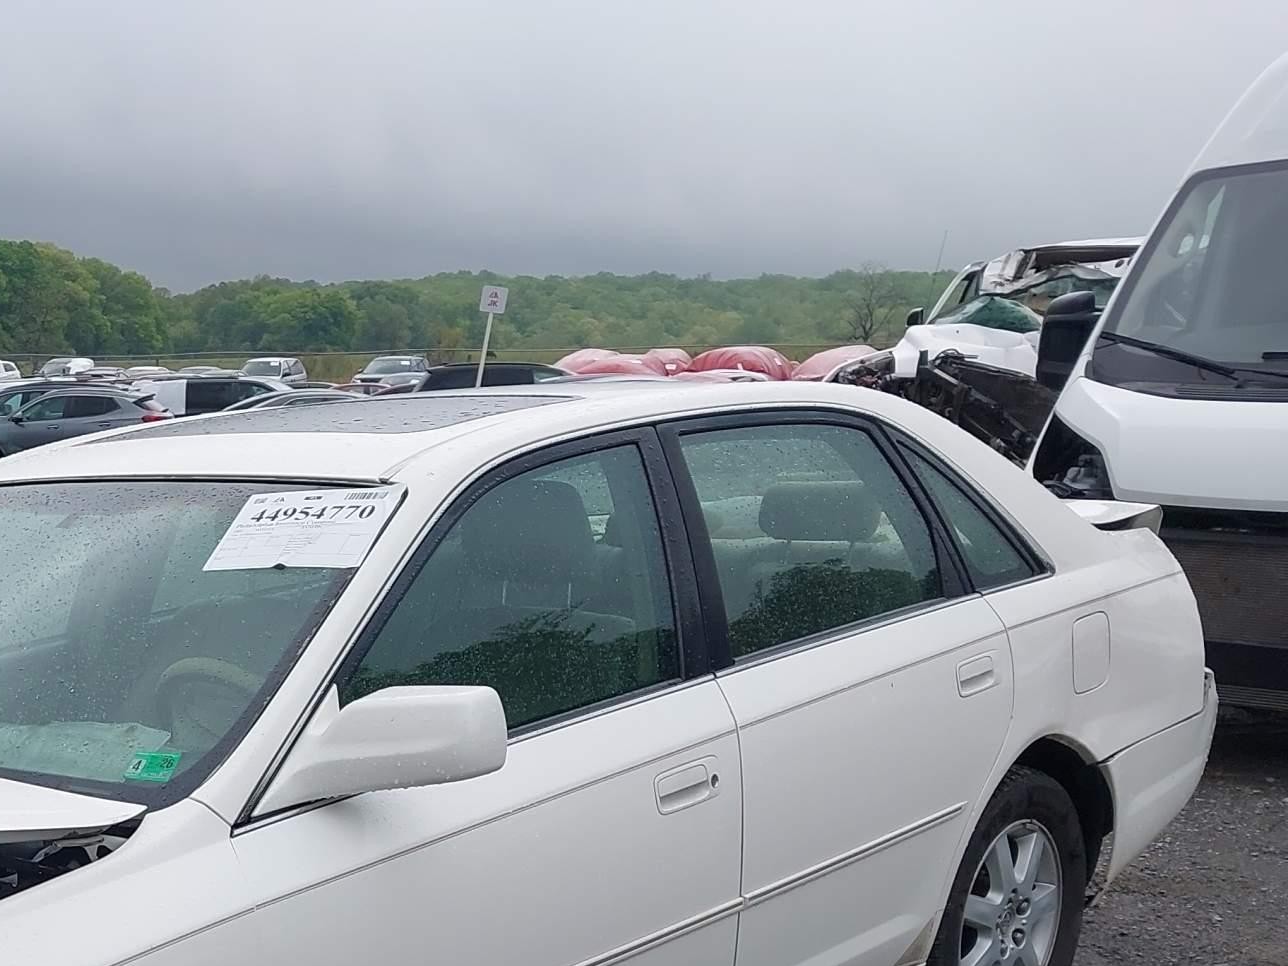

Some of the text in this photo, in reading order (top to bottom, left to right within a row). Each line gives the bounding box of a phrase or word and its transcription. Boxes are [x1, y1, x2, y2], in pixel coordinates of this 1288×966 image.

[250, 504, 376, 522] 44954770
[131, 755, 175, 771] 4 26
